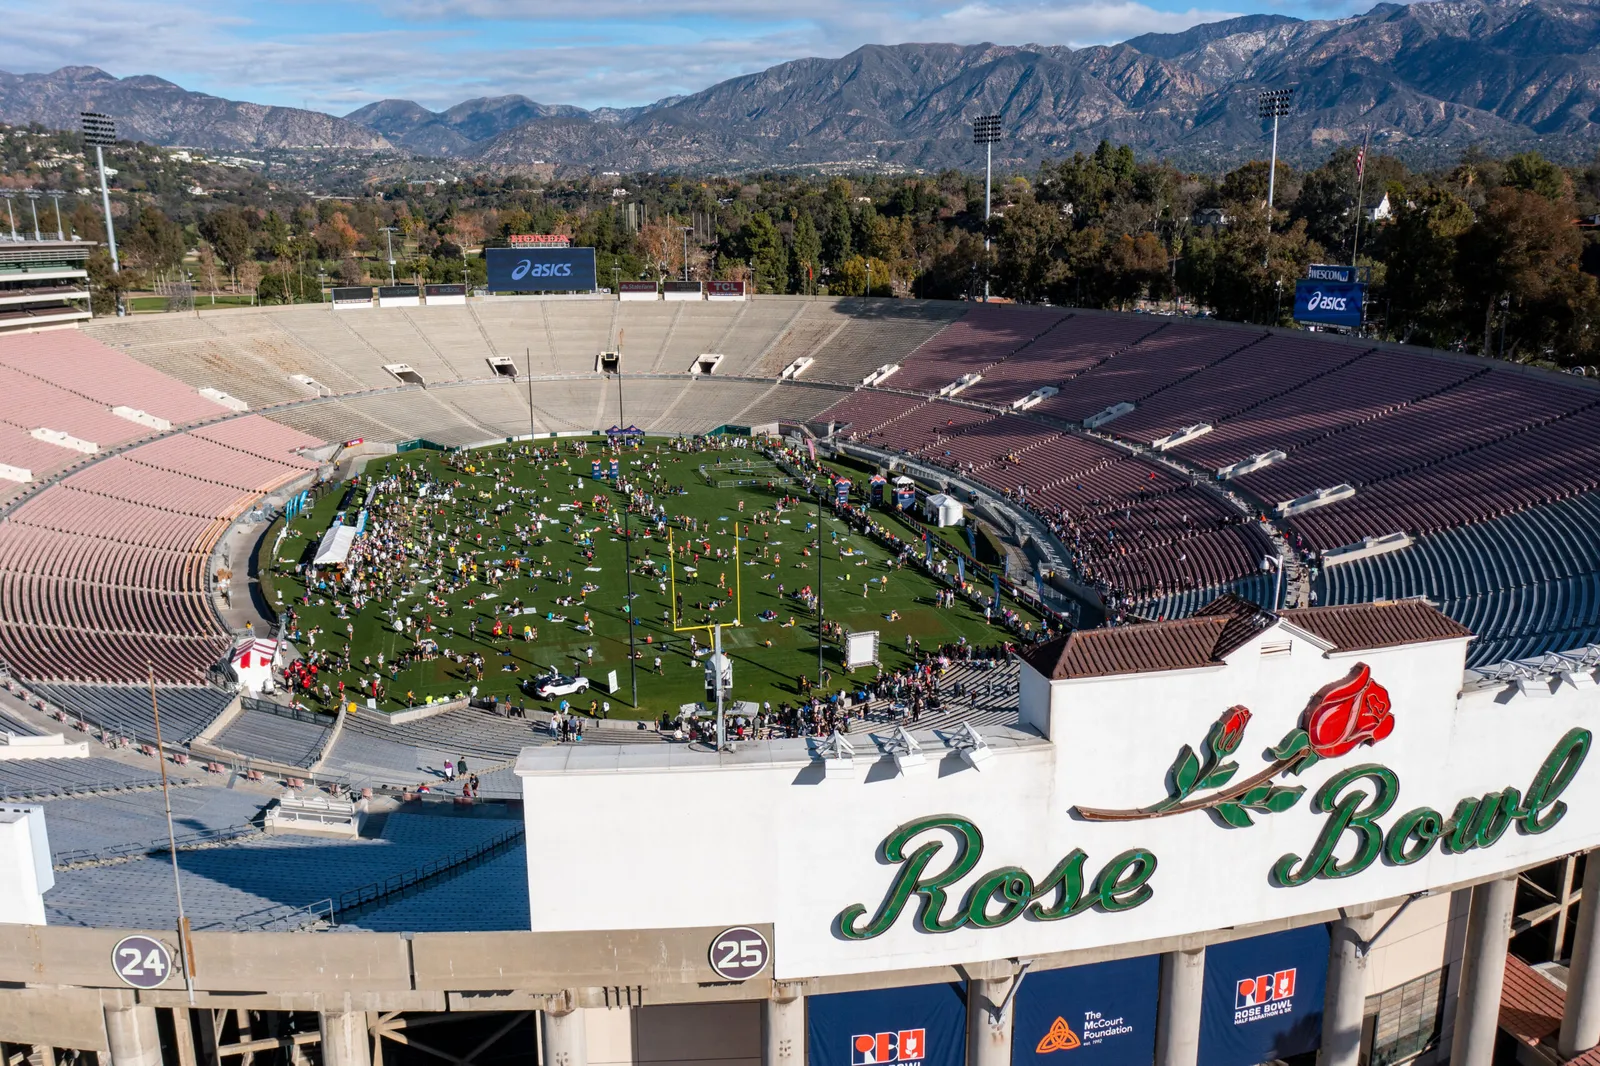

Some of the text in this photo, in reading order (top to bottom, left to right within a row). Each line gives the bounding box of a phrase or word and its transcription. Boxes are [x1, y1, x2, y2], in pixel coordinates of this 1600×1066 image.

[510, 234, 570, 243] HONDA
[1311, 269, 1340, 280] WESCOM
[714, 282, 738, 291] TCL
[840, 726, 1592, 940] Rose Bowl
[718, 939, 762, 969] 25
[119, 948, 165, 977] 24
[1084, 1011, 1101, 1020] The
[1234, 1000, 1292, 1020] ROSE BOWL
[1249, 1010, 1278, 1022] MARATHON
[1084, 1017, 1123, 1030] McCourt
[1083, 1025, 1133, 1040] Foundation
